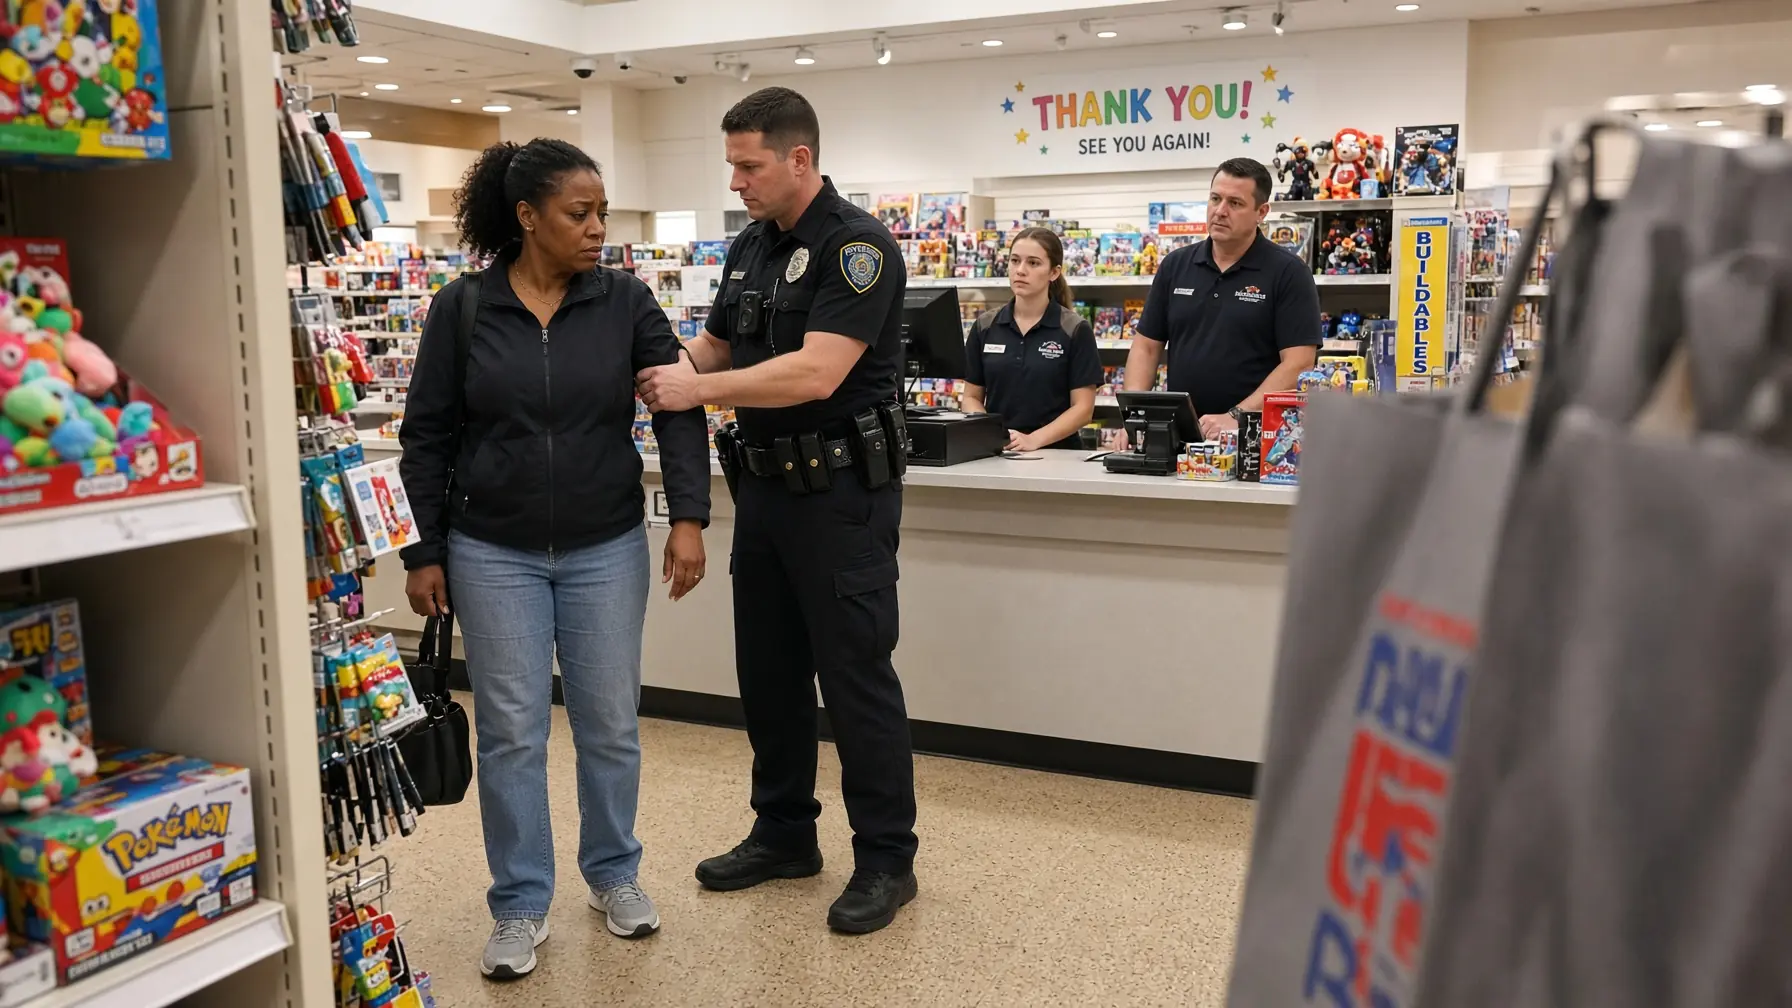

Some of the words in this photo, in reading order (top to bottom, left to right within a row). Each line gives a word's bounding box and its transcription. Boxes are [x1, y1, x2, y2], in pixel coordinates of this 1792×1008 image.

[1032, 87, 1153, 131] THANK
[1165, 80, 1253, 122] YOU!
[1078, 137, 1107, 155] SEE
[1112, 135, 1146, 153] YOU
[1152, 132, 1211, 151] AGAIN!
[1413, 231, 1432, 375] BUILDABLES
